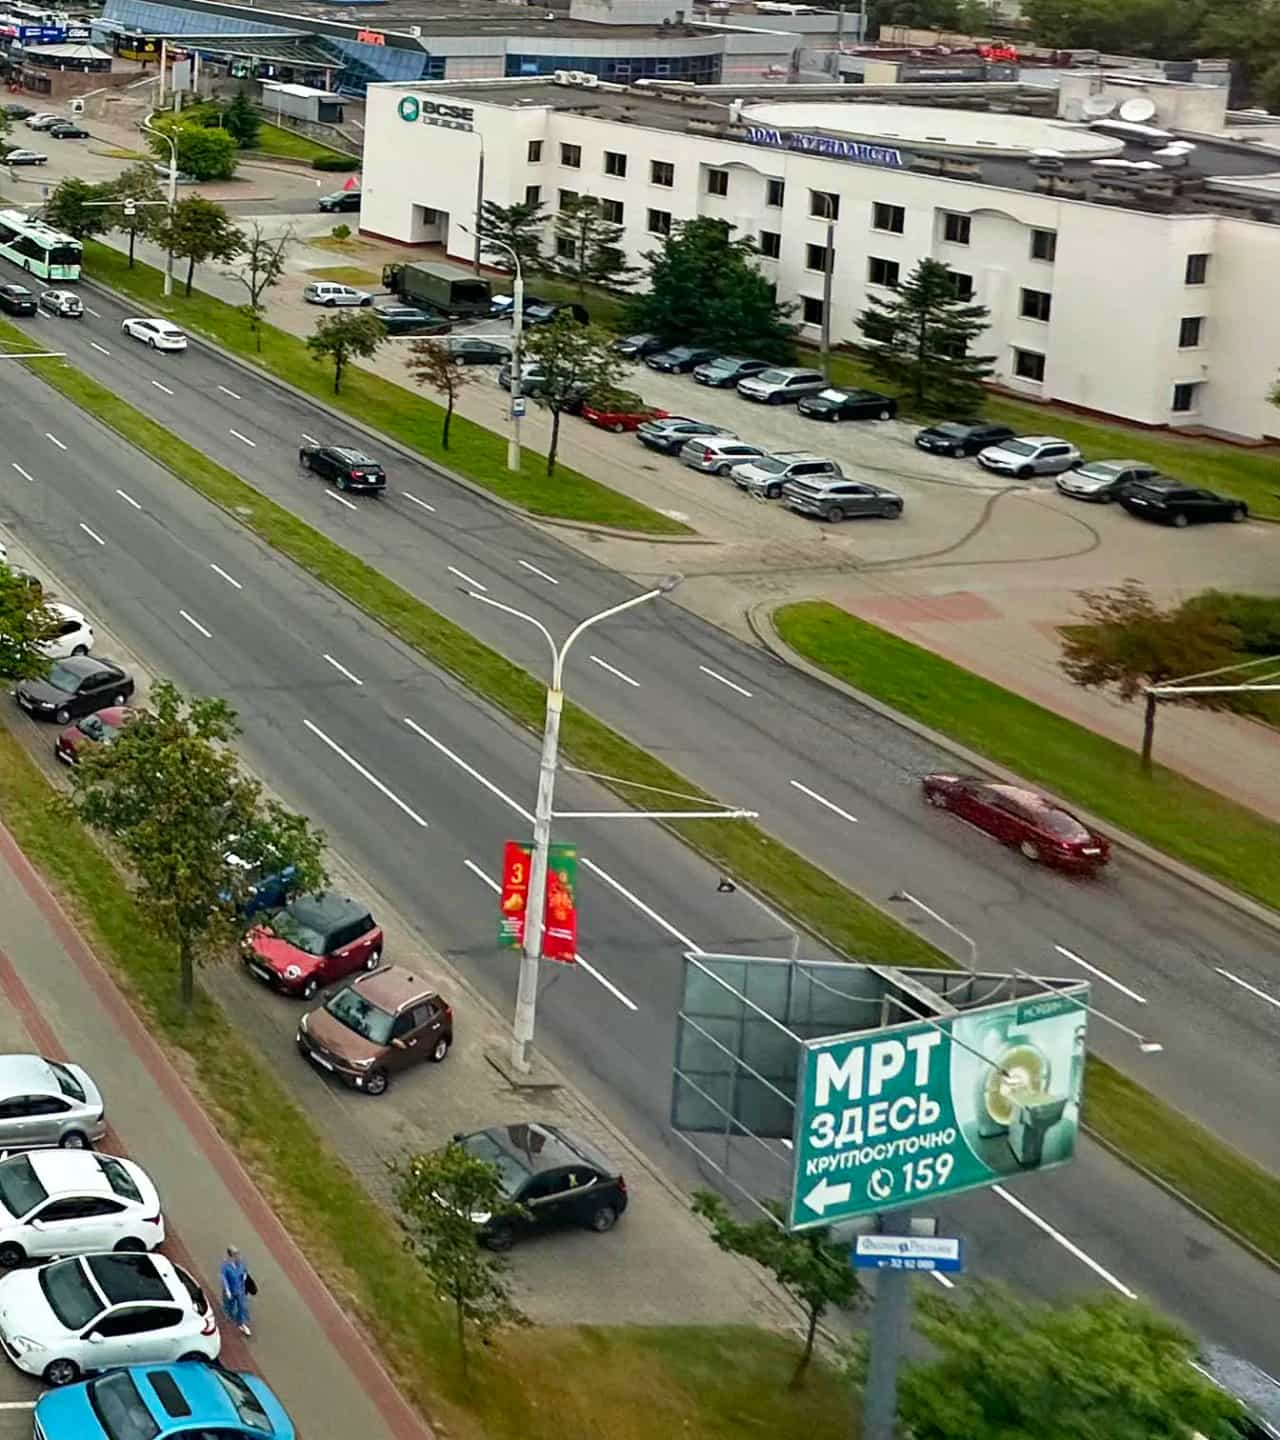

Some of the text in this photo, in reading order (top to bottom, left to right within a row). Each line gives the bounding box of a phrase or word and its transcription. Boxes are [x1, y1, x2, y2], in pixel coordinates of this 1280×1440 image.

[423, 101, 474, 121] BCSE
[745, 127, 783, 145] ДОМ
[511, 863, 523, 883] 3
[814, 1031, 941, 1107] МРТ
[809, 1092, 941, 1149] ЗДЕСЬ
[806, 1128, 957, 1176] КРУГЛОСУТОЧНО
[902, 1152, 954, 1193] 159
